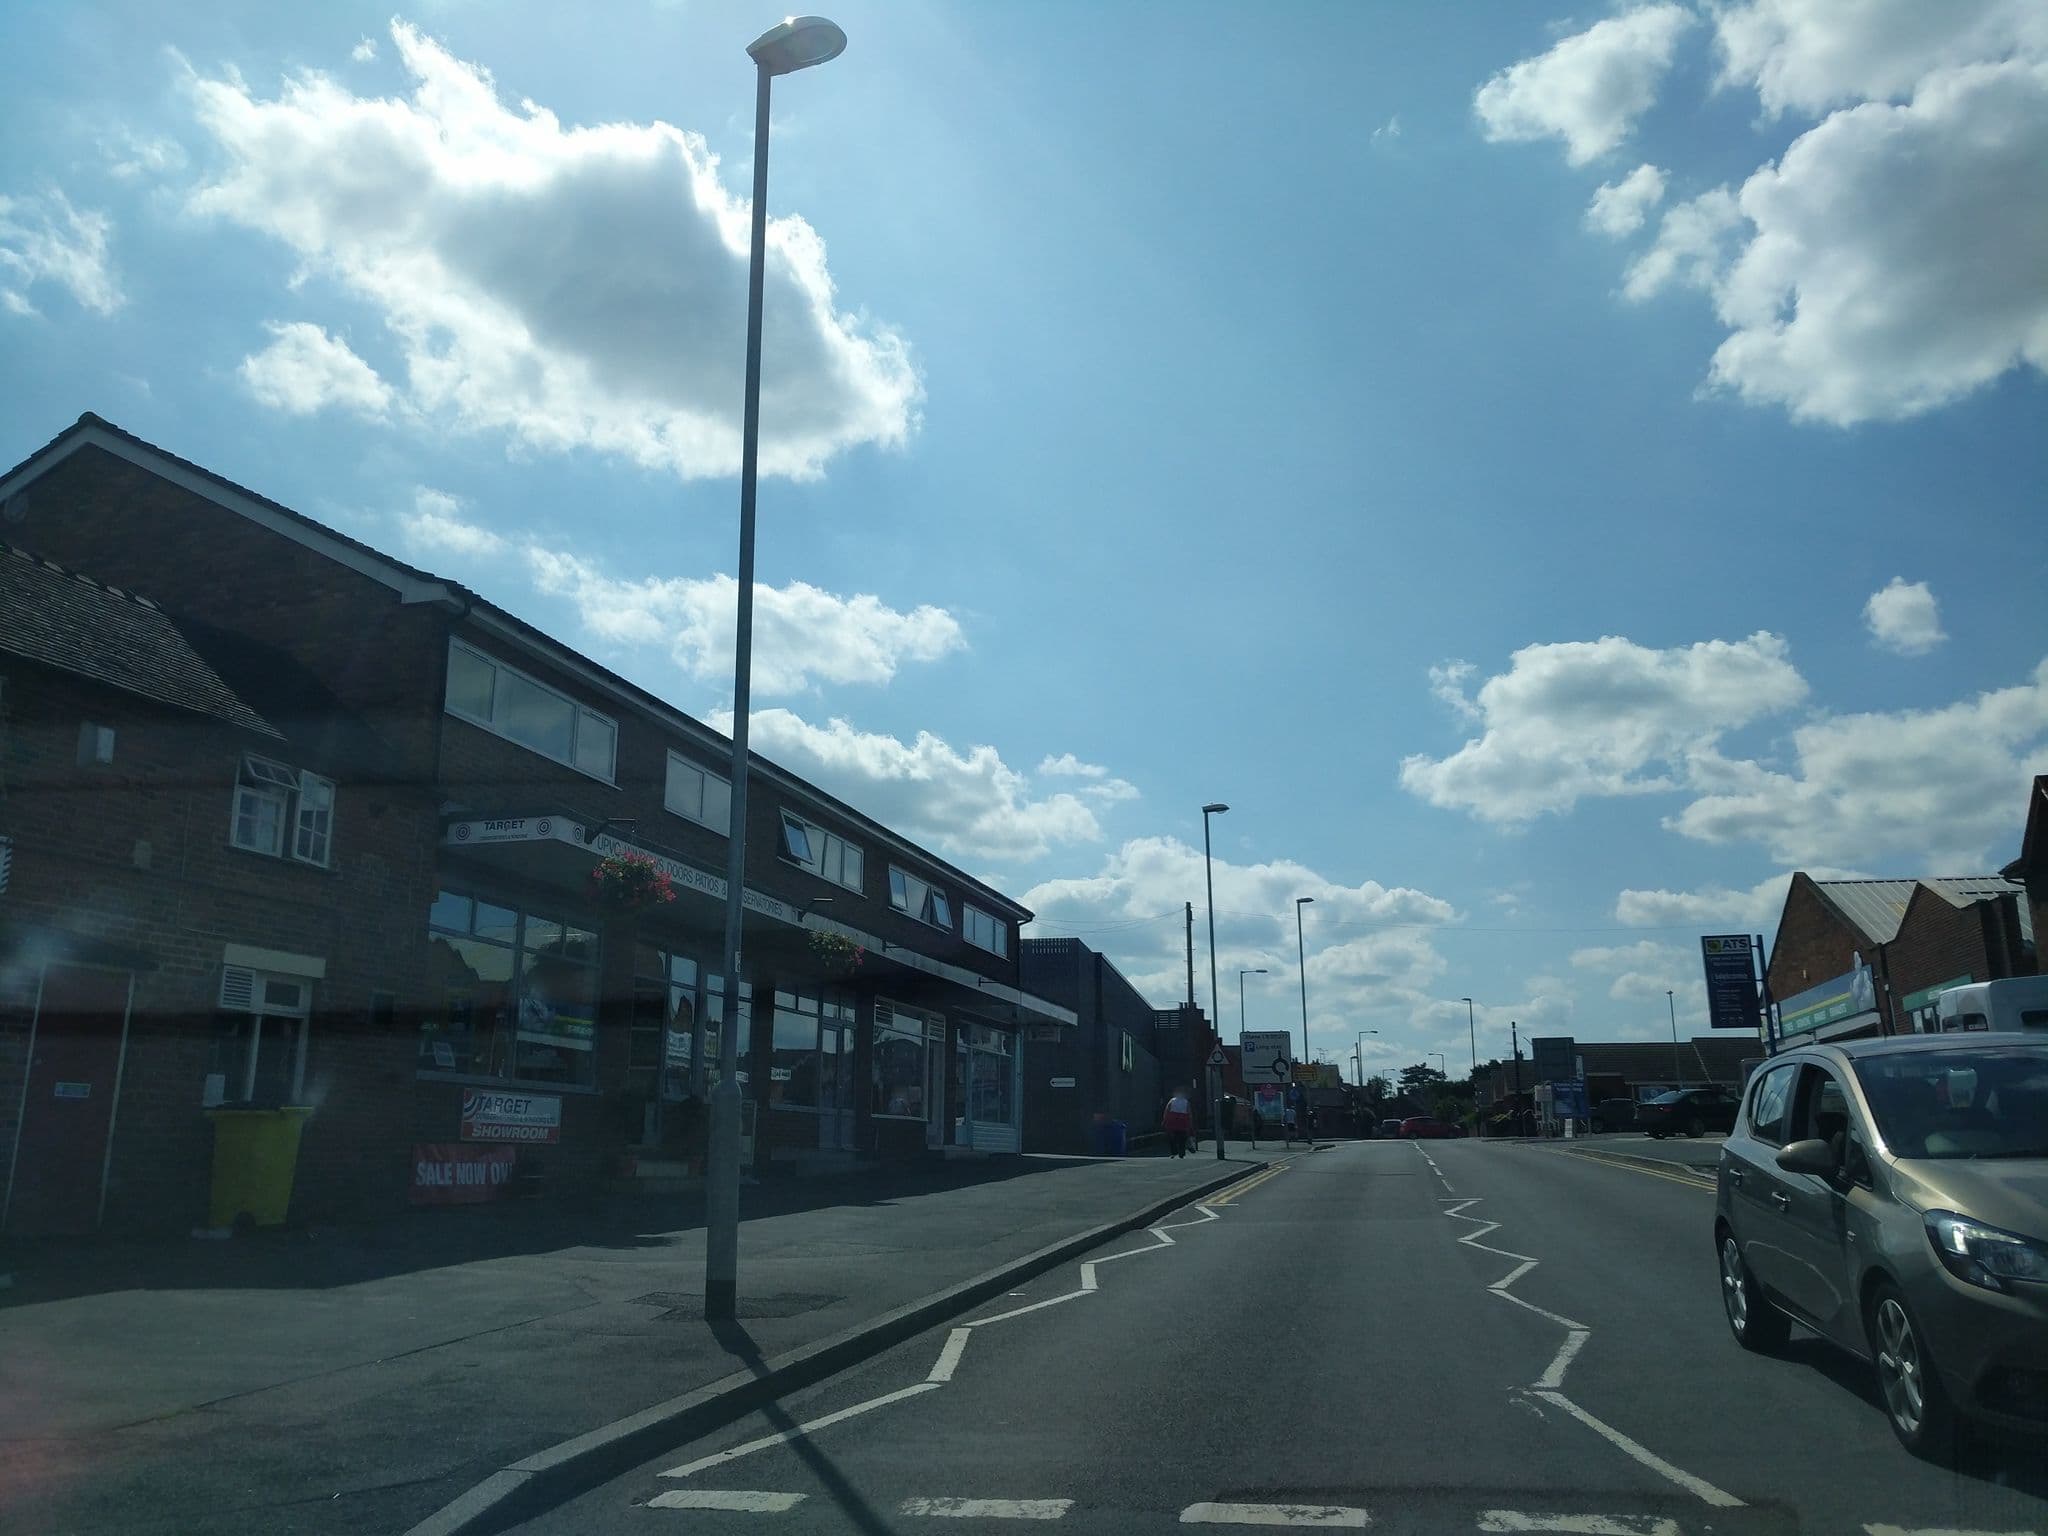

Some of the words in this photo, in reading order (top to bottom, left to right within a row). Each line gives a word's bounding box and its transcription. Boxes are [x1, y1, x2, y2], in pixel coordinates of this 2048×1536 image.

[484, 819, 526, 831] TARGET
[666, 862, 694, 884] DOORS
[695, 872, 720, 893] PATIOS
[743, 889, 783, 917] SERVATORIES
[1722, 938, 1747, 949] ATS
[478, 1095, 532, 1115] TARGET
[471, 1125, 550, 1140] SHOWROOM
[416, 1161, 453, 1186] SALE
[456, 1161, 486, 1185] NOW
